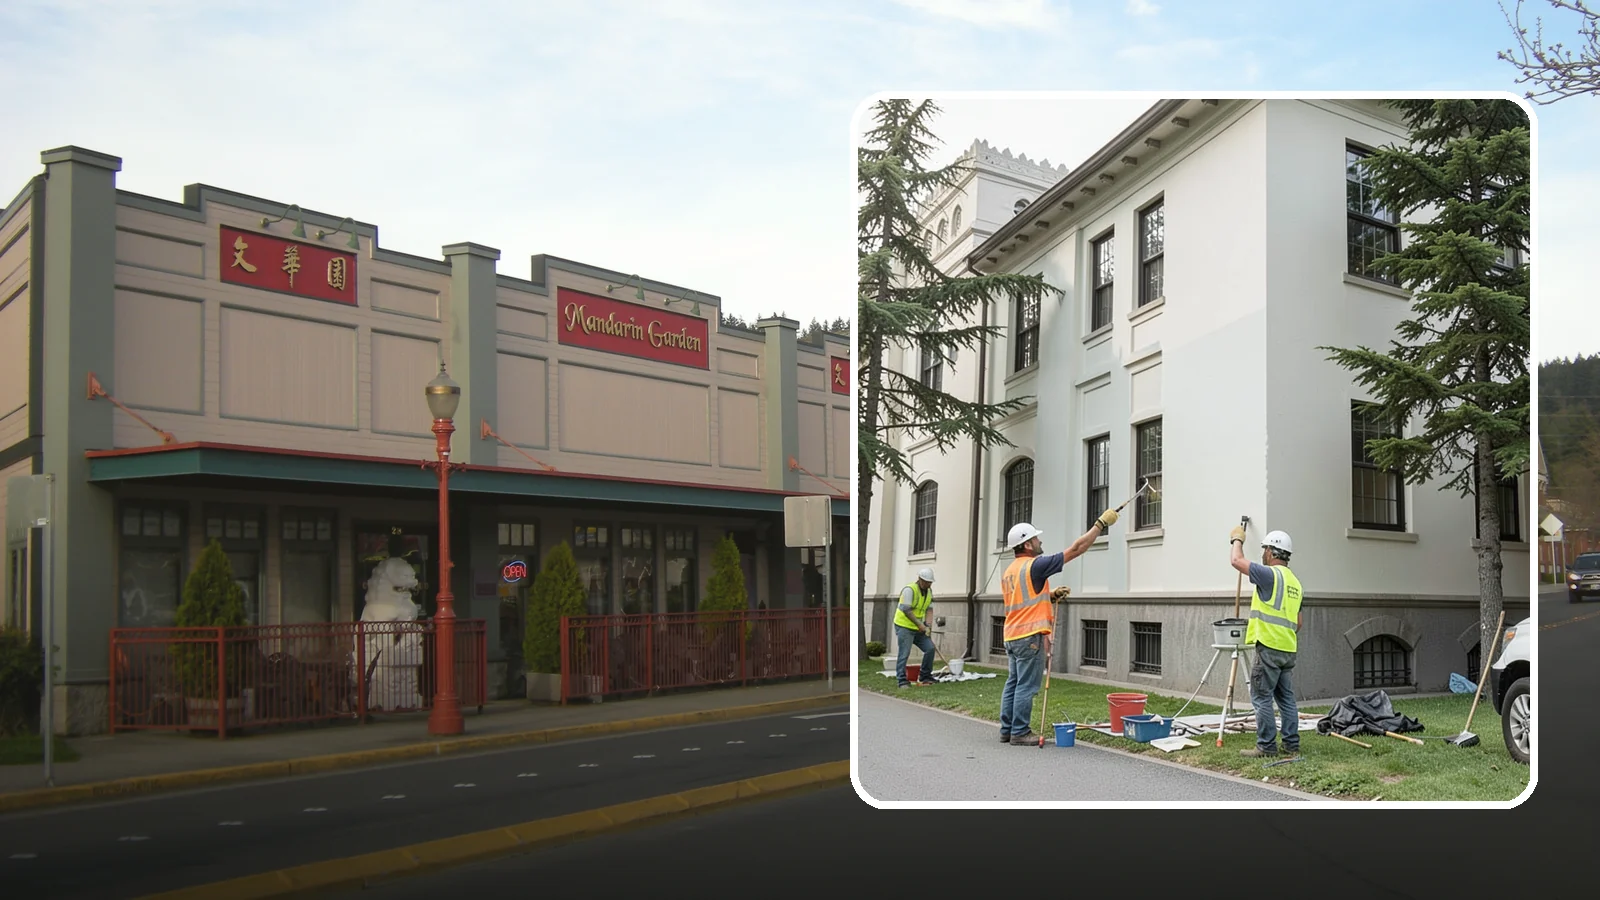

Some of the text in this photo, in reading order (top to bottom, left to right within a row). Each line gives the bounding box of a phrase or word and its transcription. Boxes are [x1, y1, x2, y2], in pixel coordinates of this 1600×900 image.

[231, 235, 346, 291] 文華園
[564, 302, 701, 352] Mandarin Garden
[503, 565, 527, 578] OPEN
